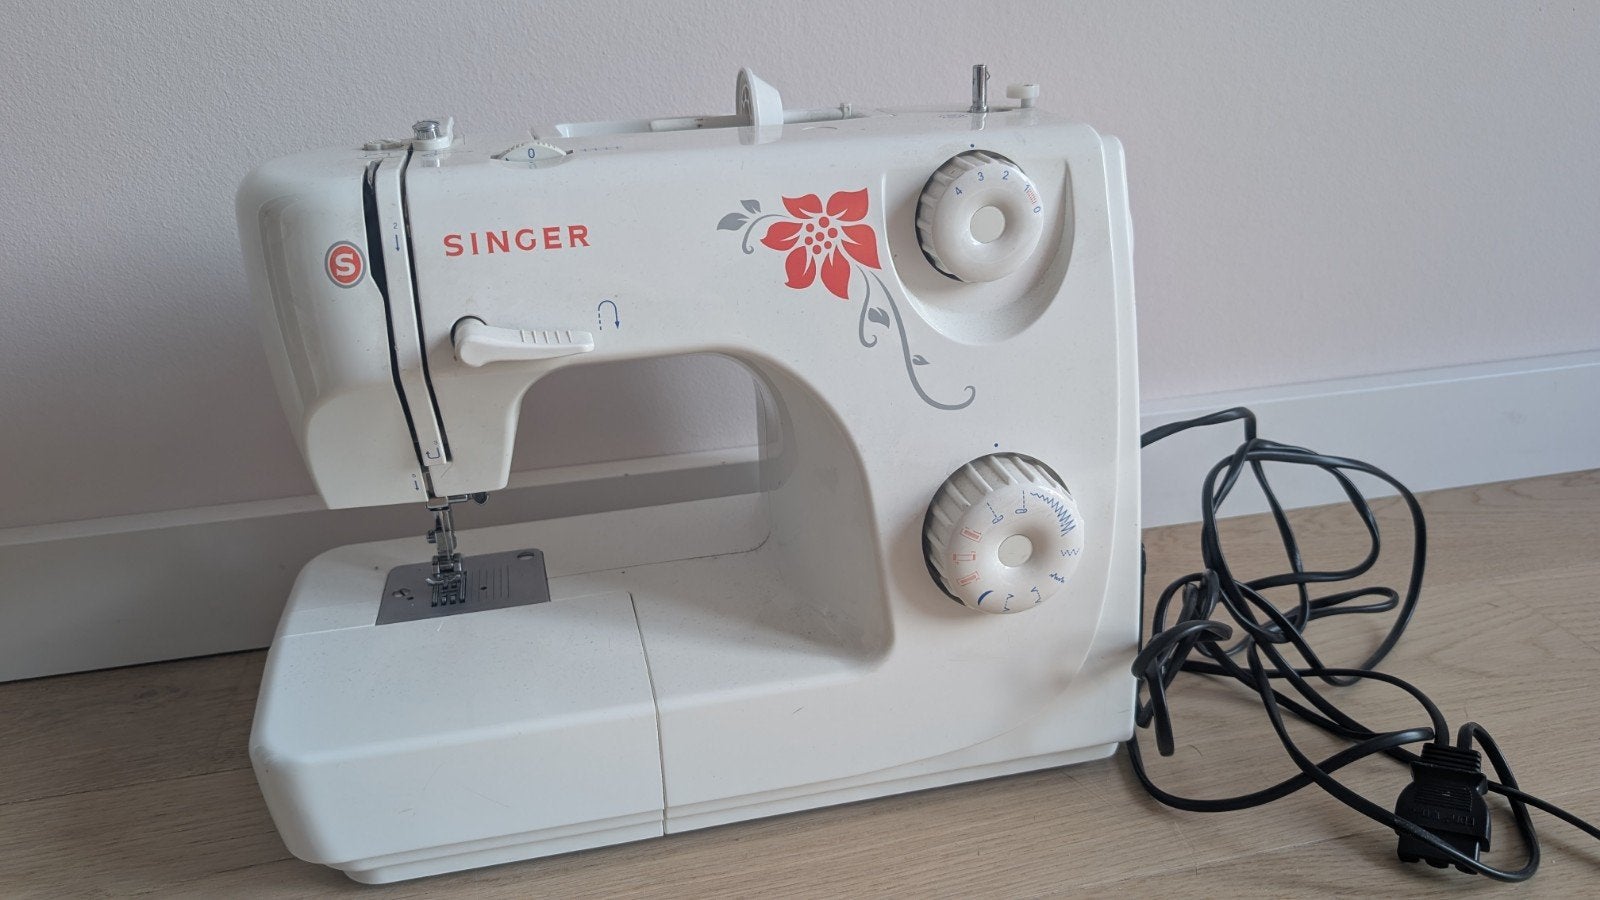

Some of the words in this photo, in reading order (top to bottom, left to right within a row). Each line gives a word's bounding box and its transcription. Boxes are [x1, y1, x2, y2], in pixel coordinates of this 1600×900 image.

[528, 148, 535, 158] 0
[955, 186, 963, 195] 4
[977, 171, 985, 181] 3
[1002, 170, 1009, 180] 2
[1033, 206, 1041, 214] 0
[443, 224, 591, 257] SINGER
[335, 253, 356, 277] S
